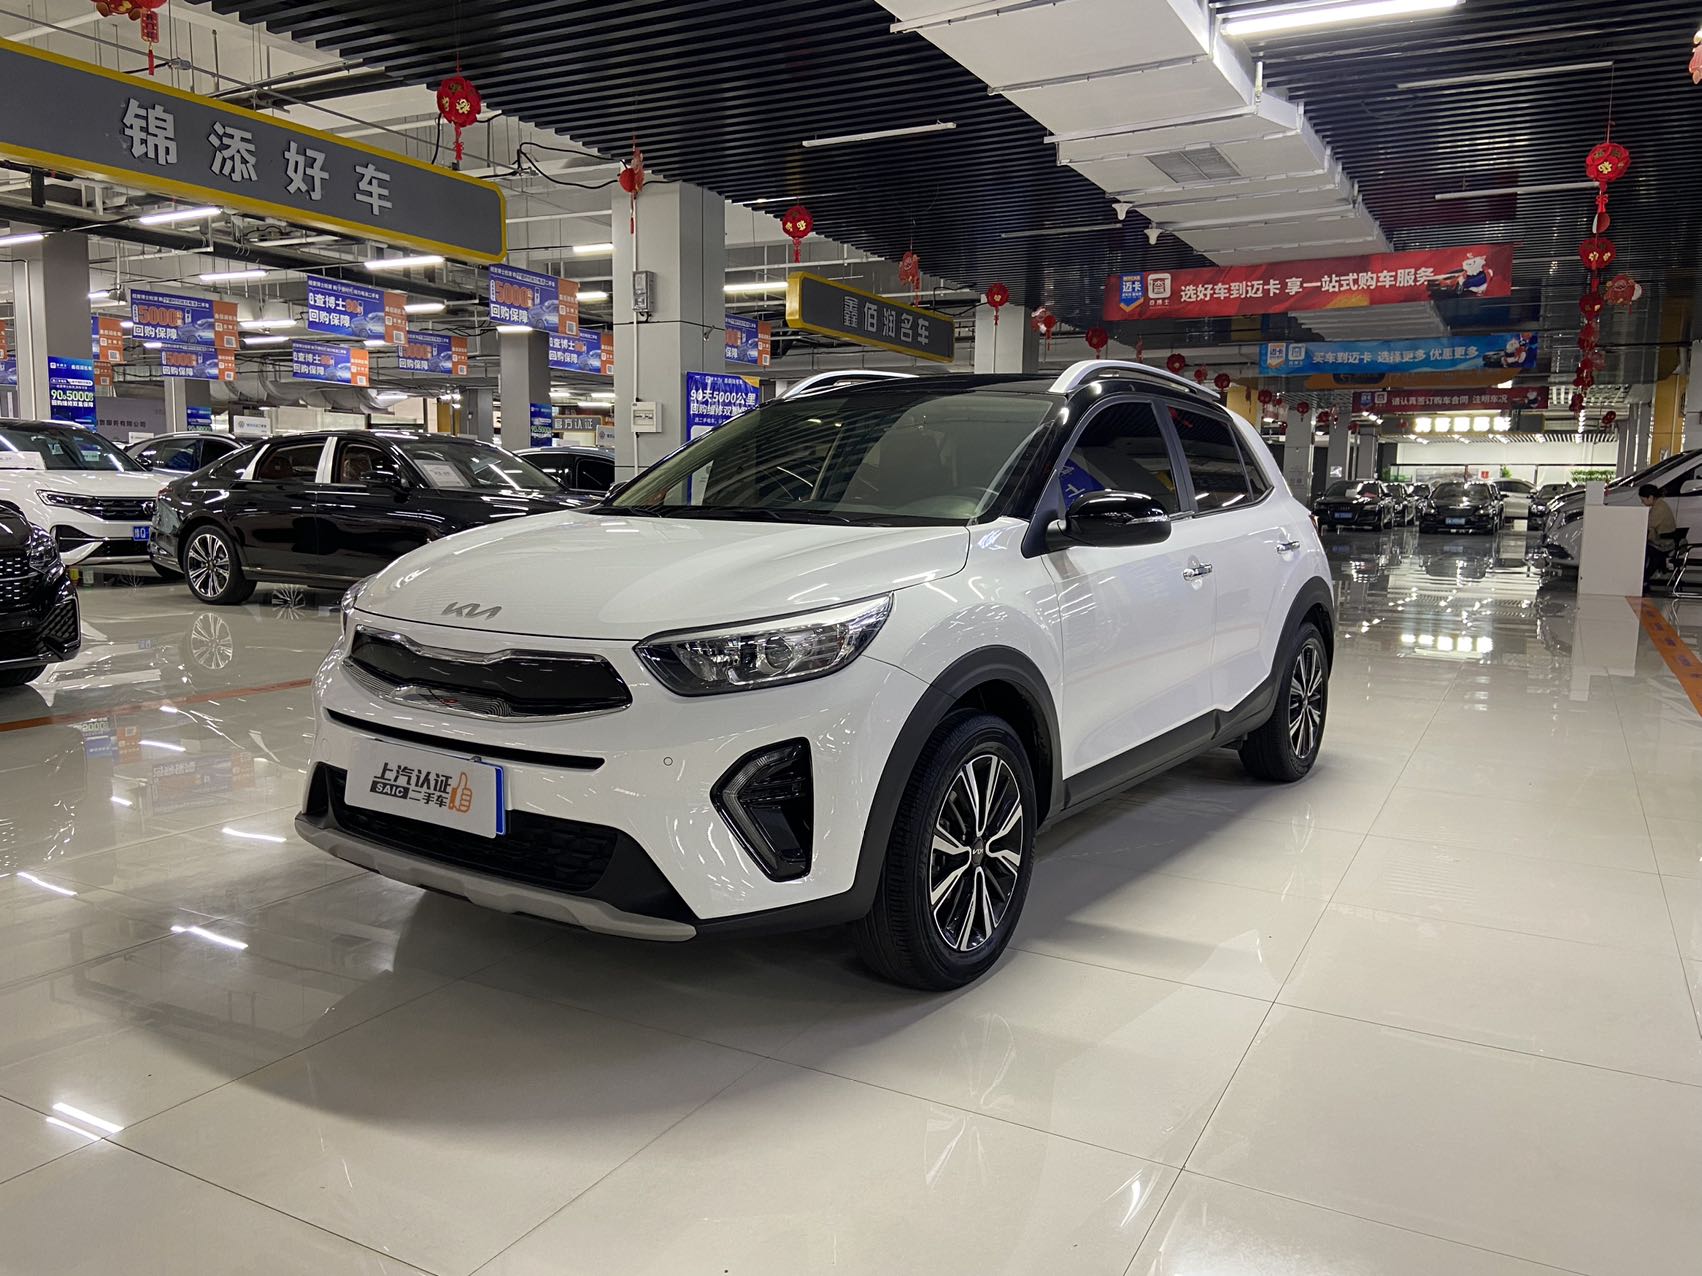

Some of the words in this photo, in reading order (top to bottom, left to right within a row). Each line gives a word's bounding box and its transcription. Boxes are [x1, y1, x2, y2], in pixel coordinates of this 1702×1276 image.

[123, 98, 393, 216] 锦添好车
[1122, 281, 1141, 292] 迈卡
[1180, 279, 1280, 302] 选好车到迈卡
[1285, 267, 1434, 295] 享一站式购车服务
[308, 309, 350, 328] 回购保障
[490, 303, 528, 323] 回购保障
[133, 324, 178, 340] 回购保障
[1312, 351, 1372, 364] 买车到迈卡
[1377, 349, 1426, 364] 选择更多
[690, 389, 756, 405] 90天5000公里
[441, 602, 502, 621] KIA
[373, 762, 453, 795] 上汽认证
[375, 783, 405, 797] SAIC
[409, 789, 449, 808] 二手车
